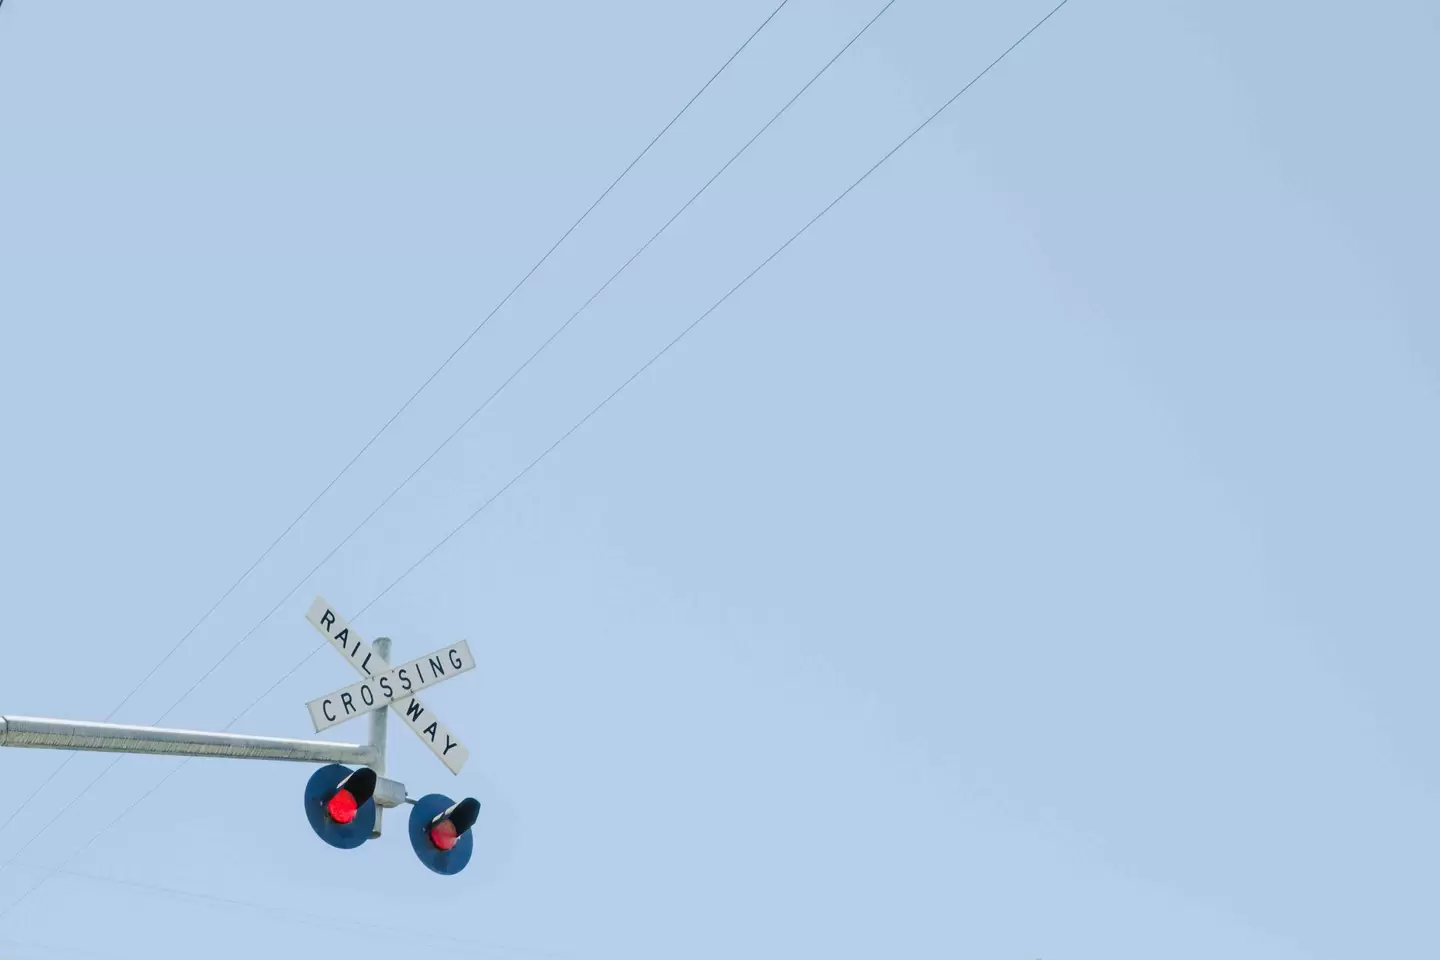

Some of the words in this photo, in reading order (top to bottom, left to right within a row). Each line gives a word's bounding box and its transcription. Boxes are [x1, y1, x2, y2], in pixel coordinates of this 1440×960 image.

[320, 609, 371, 675] RAIL
[406, 698, 457, 756] WAY
[323, 649, 462, 722] CROSSING
